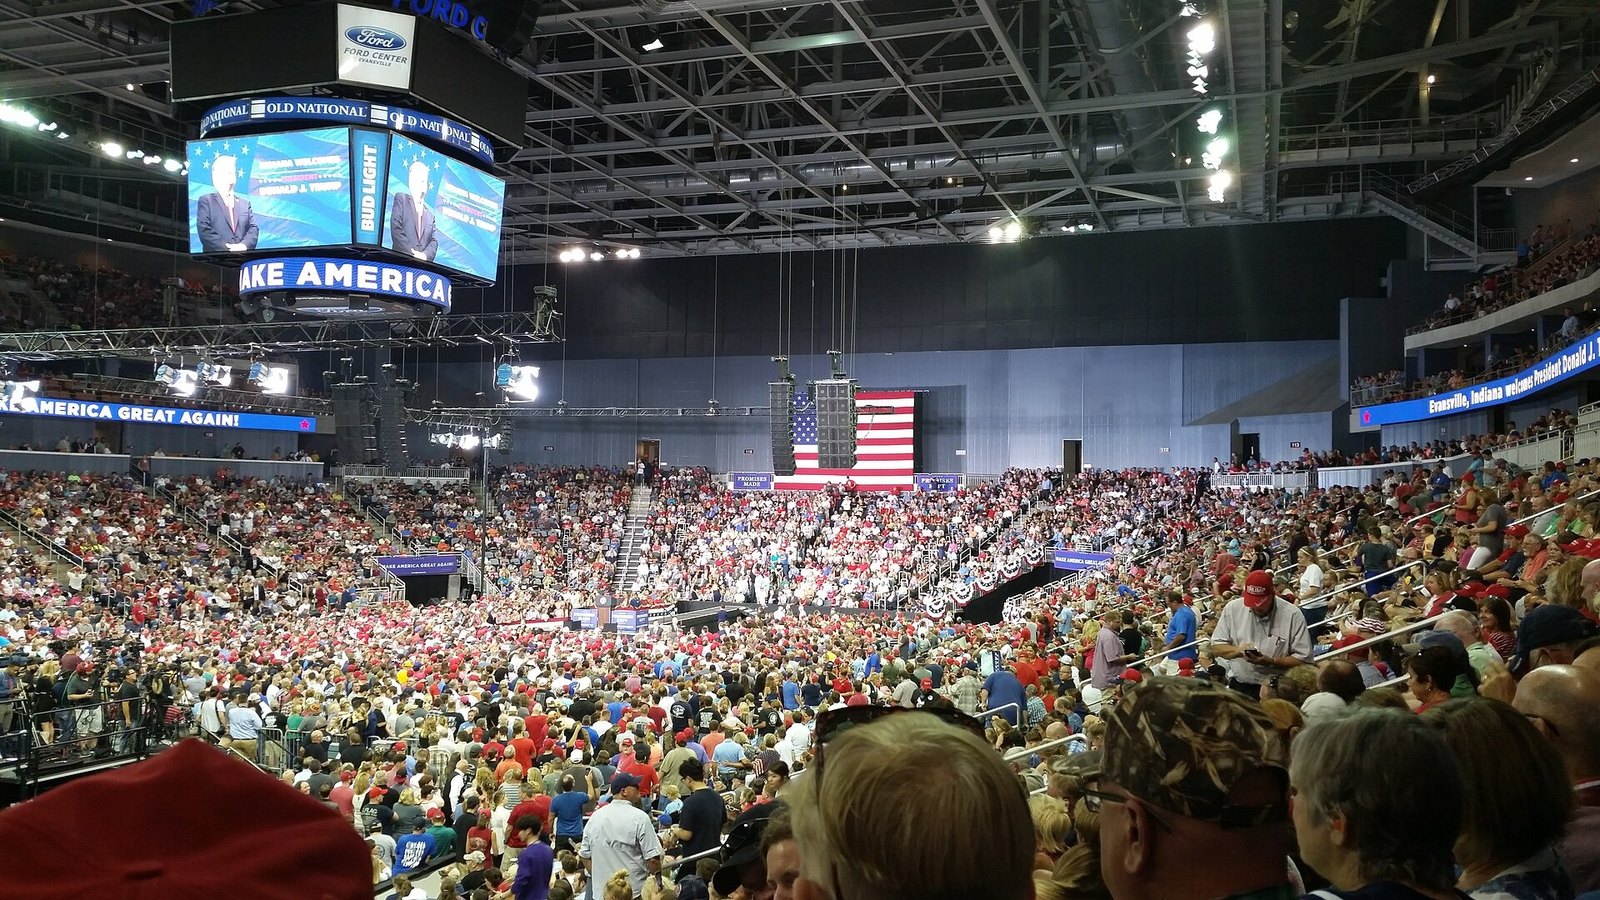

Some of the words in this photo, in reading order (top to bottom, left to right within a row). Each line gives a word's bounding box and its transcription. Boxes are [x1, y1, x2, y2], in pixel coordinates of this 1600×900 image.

[357, 29, 394, 47] Ford
[344, 47, 370, 57] FORD
[372, 52, 408, 64] CENTER
[359, 57, 392, 67] EVANSVILLE
[210, 104, 248, 123] NATIONAL
[266, 102, 294, 113] OLD
[297, 103, 367, 117] NATIONAL
[389, 112, 417, 126] OLD
[362, 144, 377, 194] LIGHT
[361, 195, 375, 231] BUD
[239, 262, 285, 292] AKE
[296, 261, 445, 303] AMERICA
[1429, 392, 1470, 414] Evansville,
[1471, 386, 1503, 405] Indiana
[1505, 374, 1533, 398] welcomes
[1533, 357, 1562, 387] President
[1562, 343, 1586, 373] Donald
[1588, 340, 1596, 361] J.
[118, 406, 176, 423] GREAT
[180, 411, 239, 427] AGAIN!
